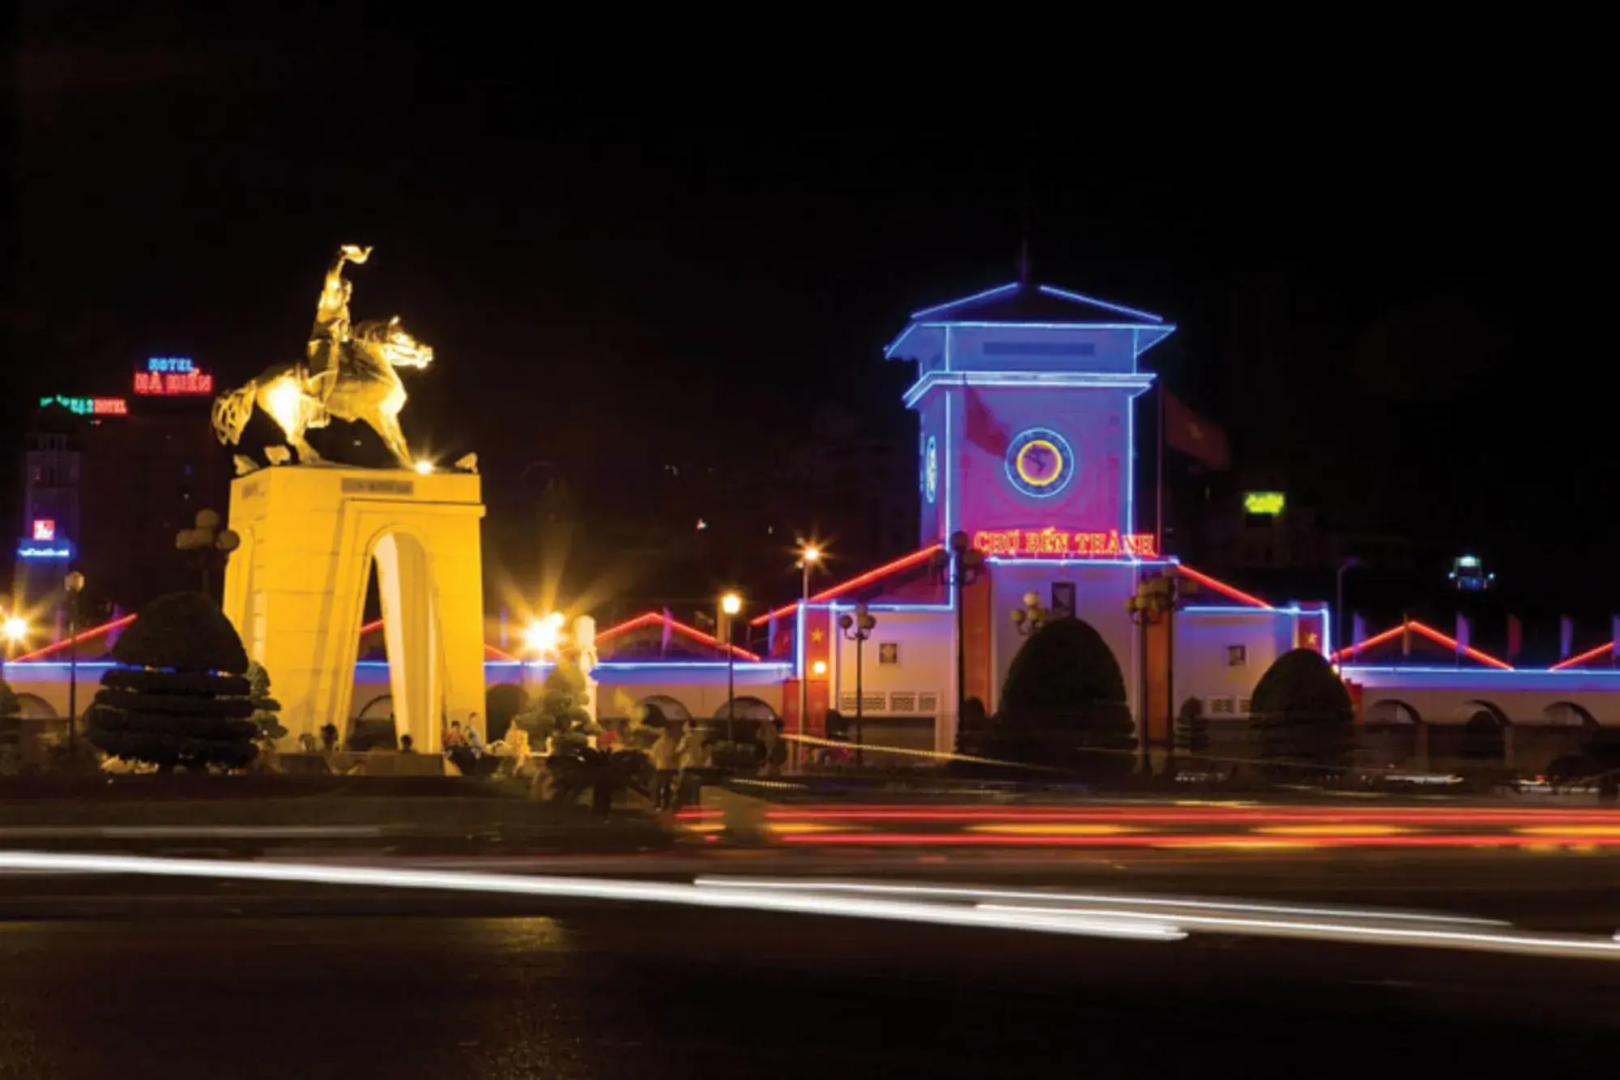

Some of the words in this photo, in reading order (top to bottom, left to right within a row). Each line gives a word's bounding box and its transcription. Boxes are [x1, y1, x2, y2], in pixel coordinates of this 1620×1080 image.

[148, 357, 194, 371] HOTEL
[974, 529, 1020, 556] CHỢ
[1025, 526, 1069, 553] BẾN
[1075, 530, 1156, 555] THÀNH
